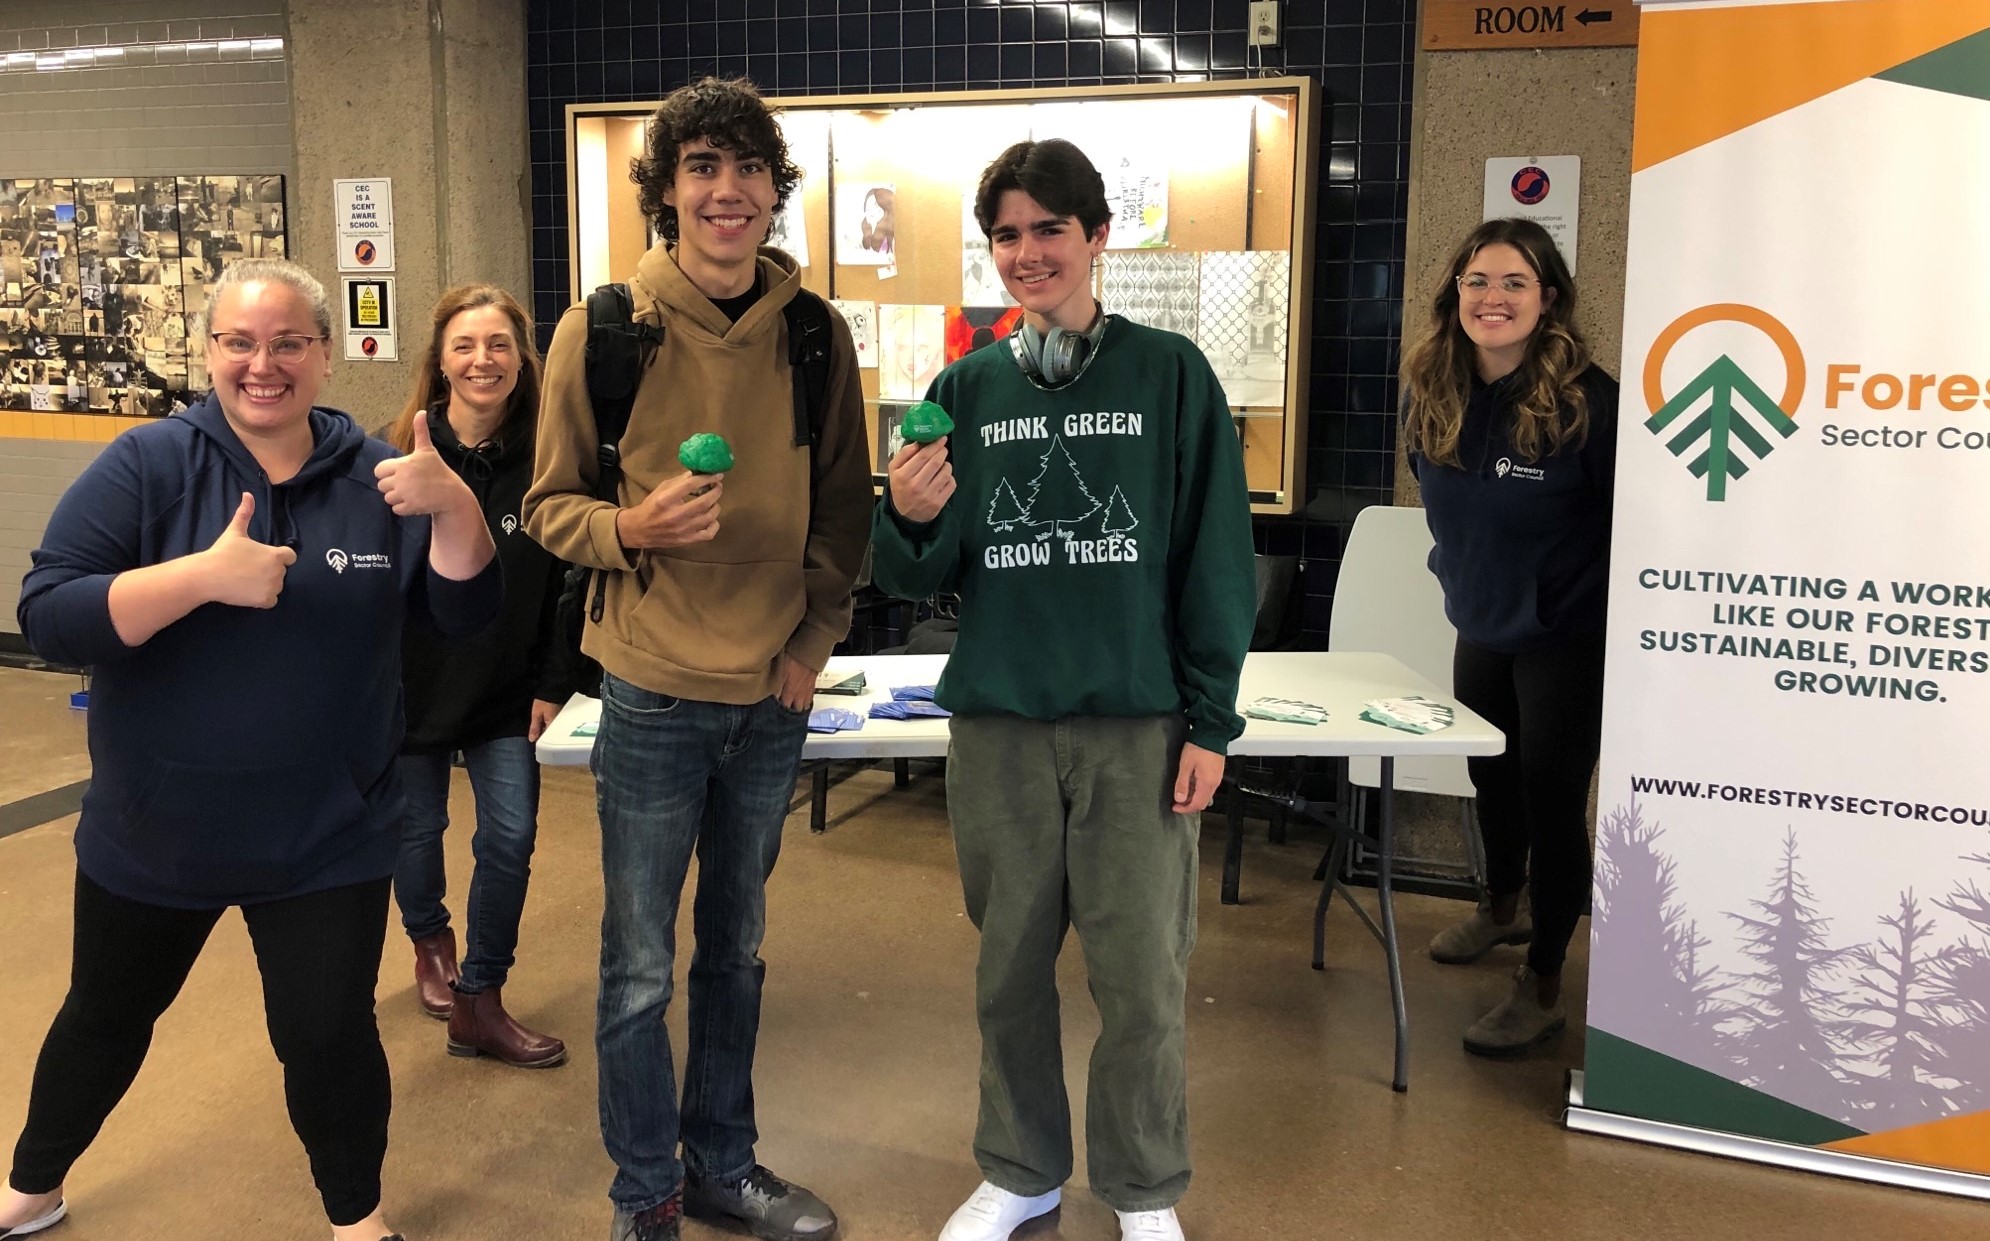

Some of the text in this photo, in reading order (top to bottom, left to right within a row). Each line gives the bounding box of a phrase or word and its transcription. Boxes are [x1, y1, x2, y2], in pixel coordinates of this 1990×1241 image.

[1474, 6, 1566, 34] ROOM
[351, 203, 375, 211] SCENT
[351, 212, 377, 220] AWARE
[349, 221, 379, 229] SCHOOL
[1825, 364, 1990, 411] Fore
[980, 412, 1143, 447] THINK GREEN
[1821, 424, 1990, 450] Sector Co
[1513, 465, 1544, 476] Forestry
[352, 554, 388, 563] Forestry
[984, 538, 1139, 569] GROW TREES
[1639, 568, 1990, 608] CULTIVATING A WORK
[1713, 603, 1990, 641] LIKE OUR FOREST
[1640, 629, 1989, 673] SUSTAINABLE, DIVERS
[1774, 670, 1947, 703] GROWING.
